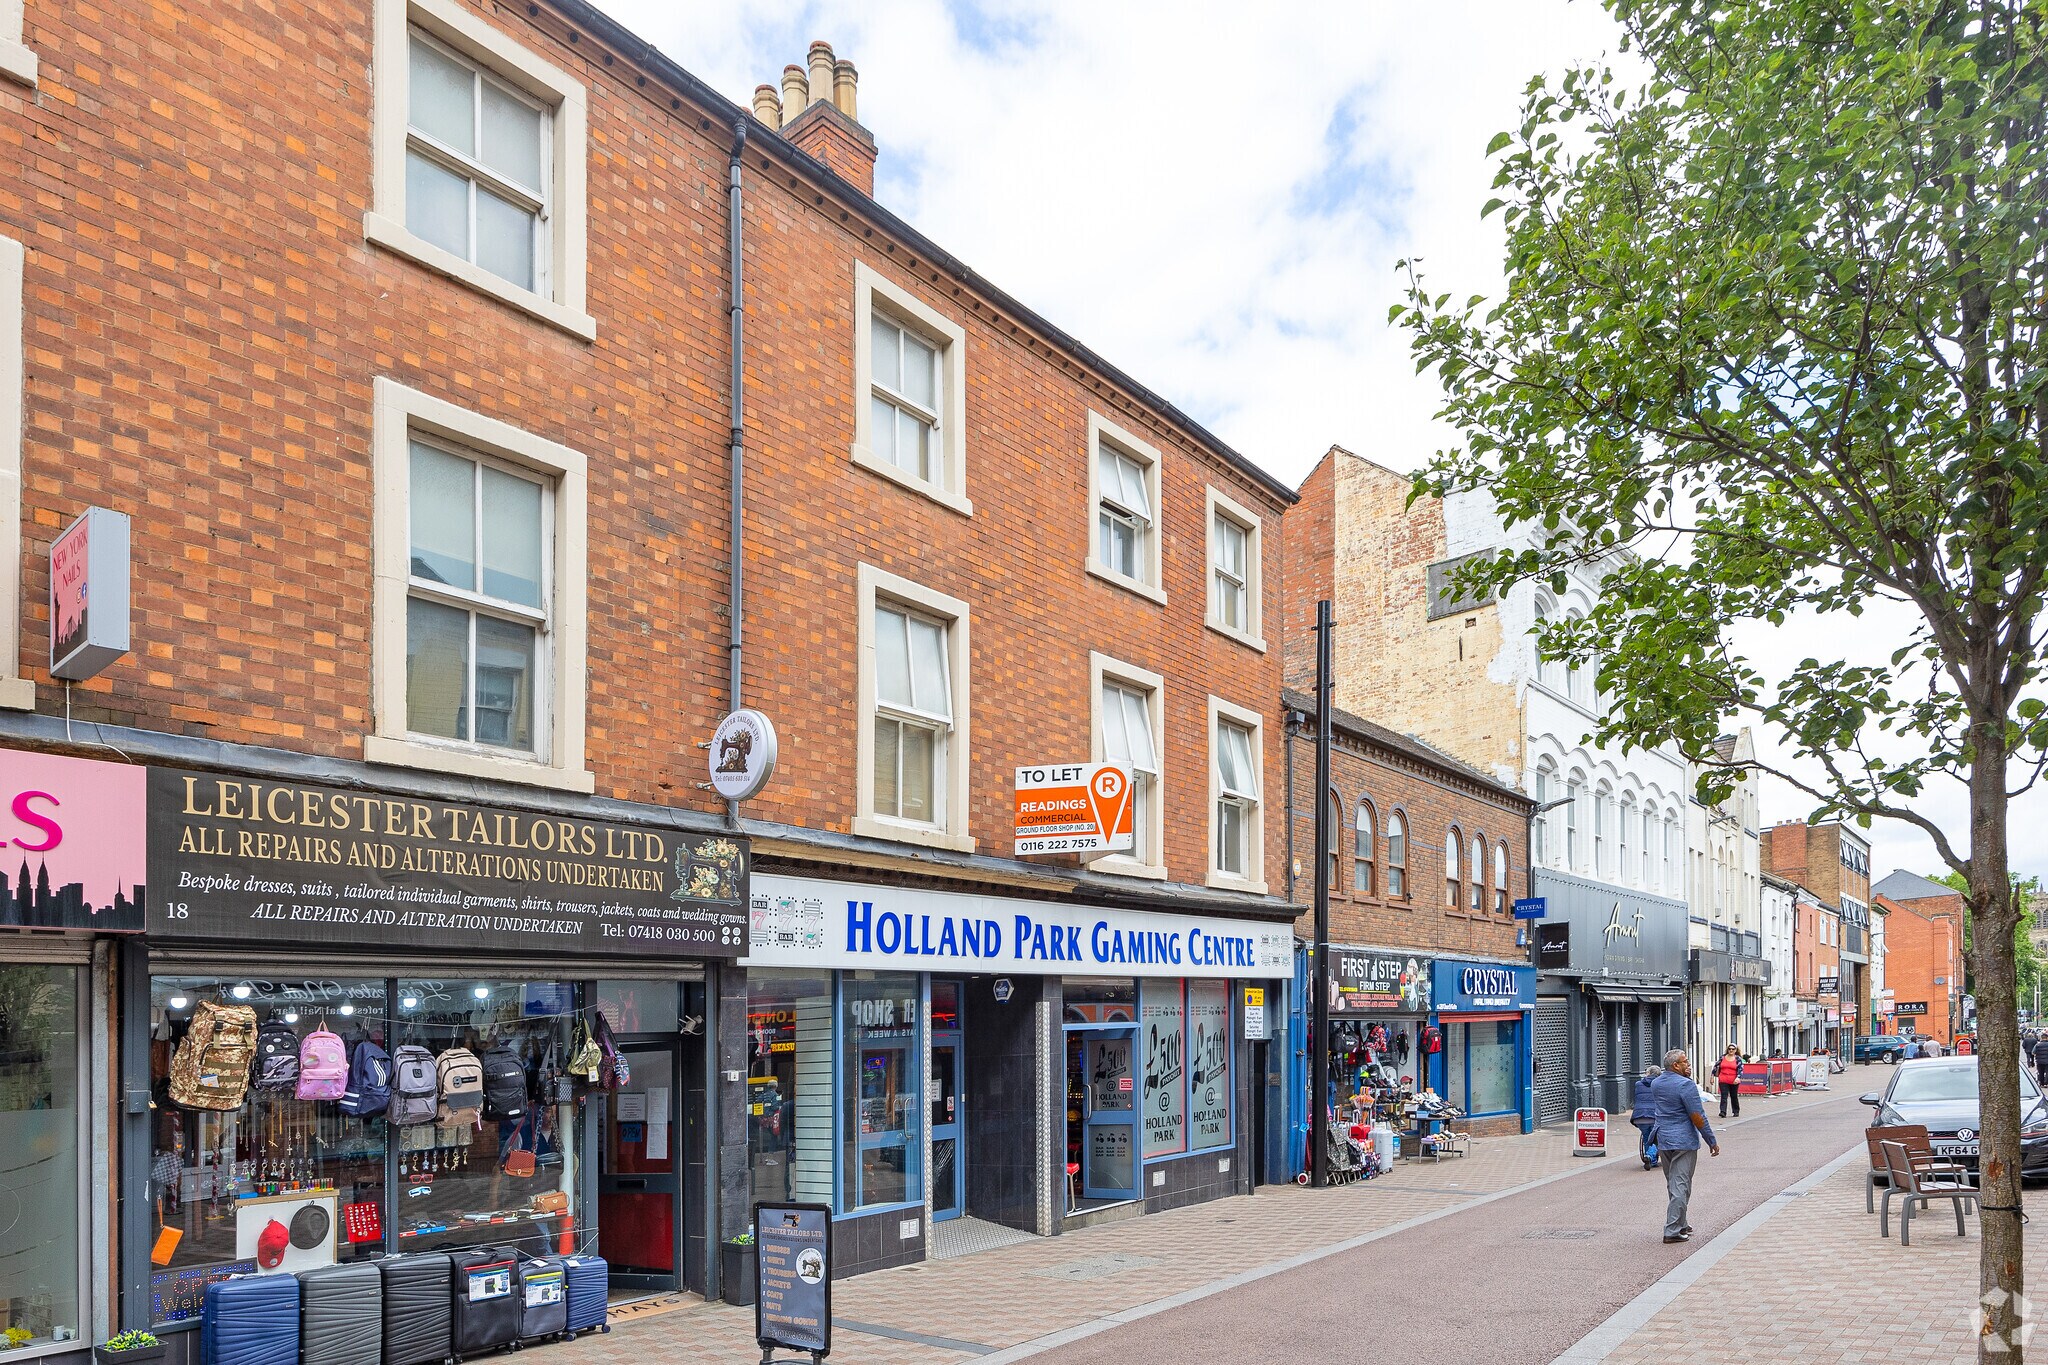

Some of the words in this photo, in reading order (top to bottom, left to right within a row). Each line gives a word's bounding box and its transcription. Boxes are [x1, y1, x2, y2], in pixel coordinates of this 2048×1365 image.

[53, 549, 67, 573] NEW
[69, 530, 88, 557] YORK
[62, 559, 81, 590] NAILS
[1022, 770, 1045, 783] TO
[1052, 768, 1082, 782] LET
[1102, 777, 1115, 792] R
[1021, 799, 1087, 812] READINGS
[182, 776, 436, 840] LEICESTER
[443, 807, 597, 856] TAILORS
[605, 828, 668, 864] LTD.
[1021, 813, 1086, 824] COMMERCIAL
[1016, 825, 1039, 834] GROUND
[1040, 824, 1058, 833] FLOOR
[1058, 824, 1074, 832] SHOP
[1021, 841, 1044, 851] 0116
[1048, 840, 1068, 849] 222
[1072, 838, 1097, 849] 7575
[178, 825, 232, 856] ALL
[238, 830, 342, 865] REPAIRS
[346, 841, 397, 869] AND
[400, 846, 542, 882] ALTERATIONS
[546, 859, 664, 892] UNDERTAKEN
[178, 871, 240, 894] Bespoke
[244, 875, 297, 897] dresses,
[300, 880, 332, 897] suits
[344, 883, 395, 901] tailored
[397, 885, 461, 906] individual
[462, 893, 519, 911] garments,
[521, 896, 553, 912] shirts,
[556, 900, 598, 916] trousers,
[598, 901, 635, 918] jackets,
[637, 907, 661, 919] coats
[662, 906, 681, 920] and
[682, 909, 719, 925] wedding
[720, 912, 748, 926] gowns.
[167, 902, 189, 920] 18
[250, 903, 286, 920] ALL
[290, 905, 359, 923] REPAIRS
[360, 907, 396, 925] AND
[397, 909, 491, 931] ALTERATION
[493, 917, 583, 935] UNDERTAKEN
[600, 923, 624, 938] Tel:
[628, 925, 663, 940] 07418
[666, 927, 690, 941] 030
[693, 929, 715, 942] 500
[846, 900, 1001, 958] HOLLAND
[1014, 914, 1082, 961] PARK
[1091, 920, 1182, 965] GAMING
[1188, 927, 1256, 967] CENTRE
[1341, 957, 1369, 978] FIRST
[1379, 960, 1402, 980] STEP
[1360, 981, 1374, 991] FIRM
[1375, 982, 1391, 992] STEP
[1464, 967, 1519, 995] CRYSTAL
[1106, 1080, 1116, 1092] @
[1095, 1093, 1127, 1101] HOLLAND
[1158, 1092, 1170, 1112] @
[1205, 1087, 1215, 1106] @
[1146, 1114, 1183, 1130] HOLLAND
[1193, 1108, 1227, 1123] HOLLAND
[1154, 1129, 1175, 1143] PARK
[1201, 1122, 1220, 1135] PARK
[1941, 1146, 1968, 1155] KF64
[761, 1226, 786, 1235] LEICESTER
[787, 1229, 810, 1237] TAILORS
